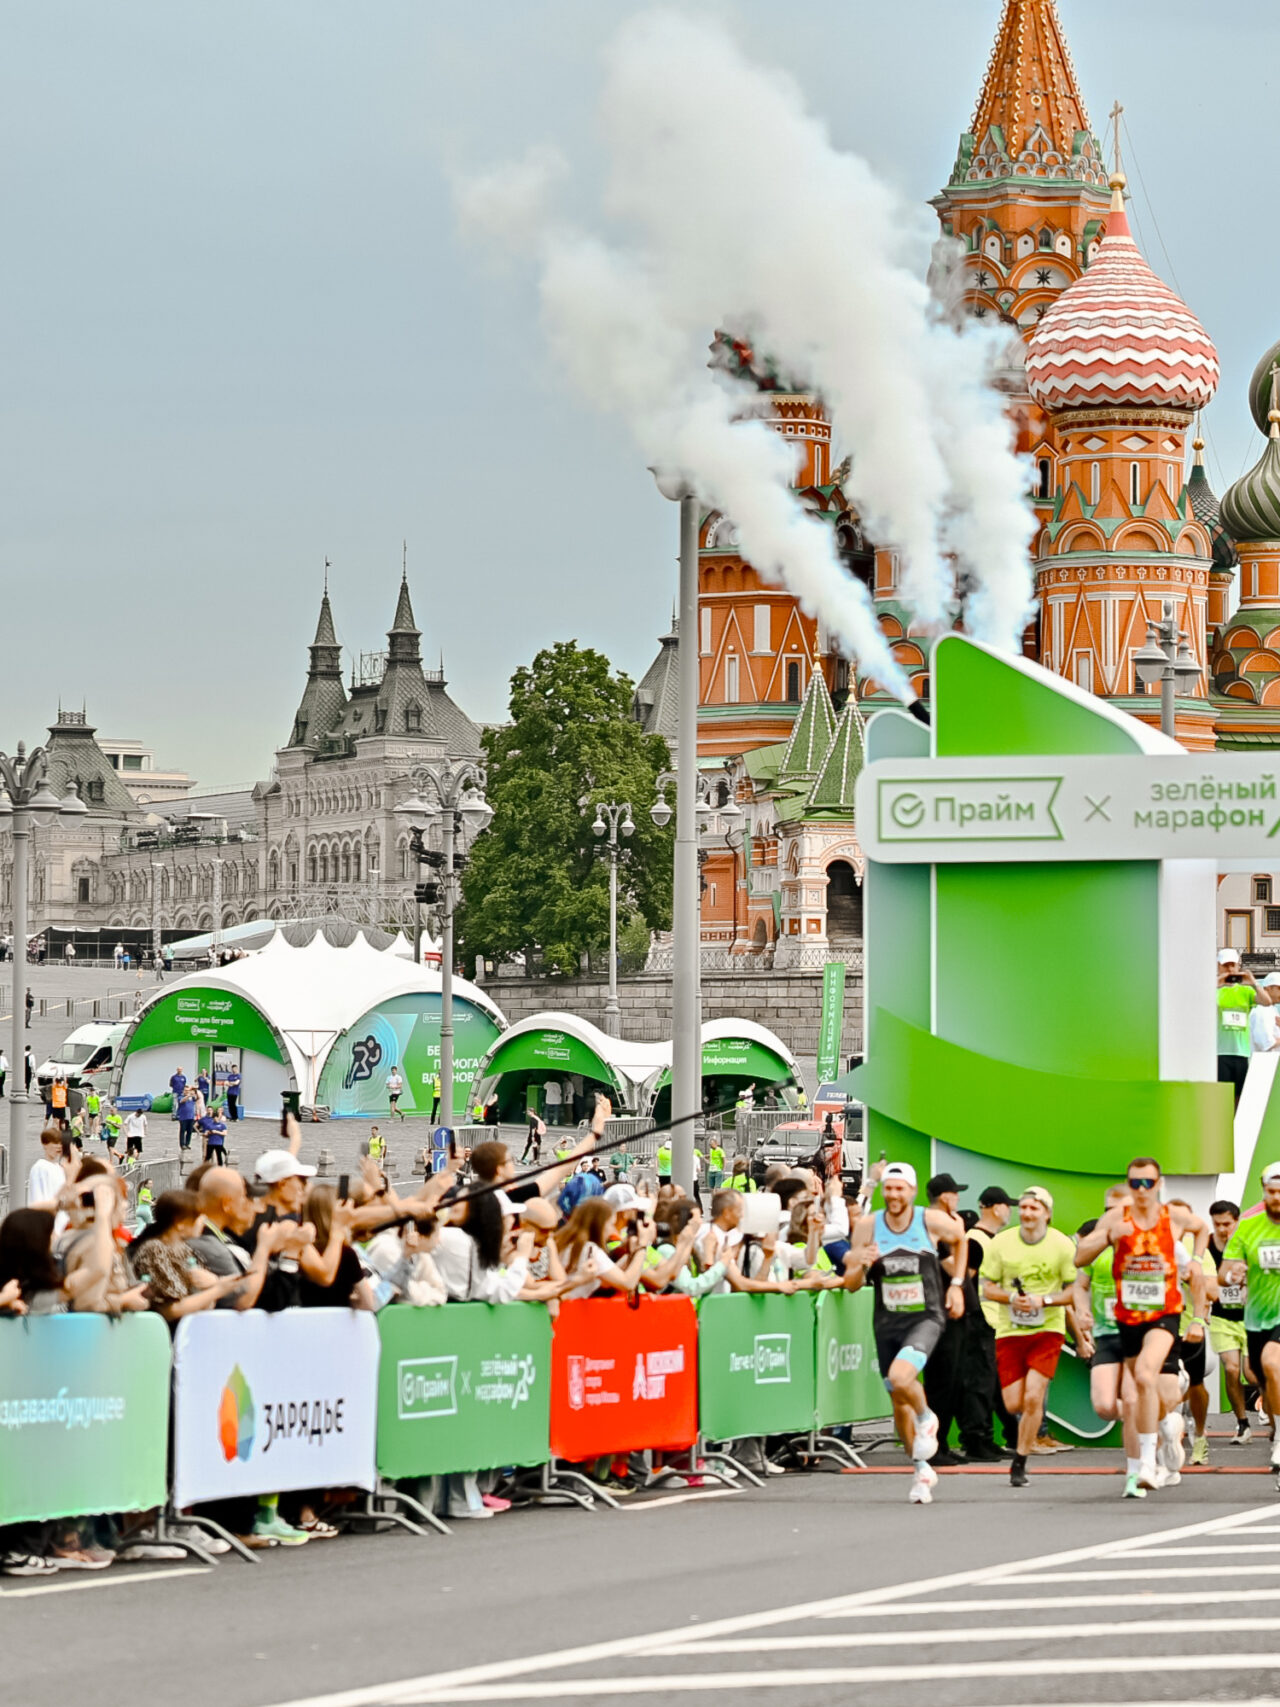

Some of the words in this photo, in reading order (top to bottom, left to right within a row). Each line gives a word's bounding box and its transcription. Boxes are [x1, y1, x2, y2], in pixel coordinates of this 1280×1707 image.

[1150, 774, 1277, 801] зелёный
[934, 794, 1036, 828] Прайм
[1134, 804, 1265, 833] марафон
[826, 971, 838, 1051] ИНФОРМАЦИЯ
[434, 1057, 482, 1069] ПМОГА
[703, 1055, 747, 1066] Информация
[1128, 1284, 1159, 1296] 7608
[480, 1353, 518, 1377] зелёный
[766, 1346, 786, 1371] Прайм
[840, 1343, 863, 1371] СБЕР
[416, 1373, 450, 1403] Прайм
[475, 1378, 515, 1404] марафон
[263, 1398, 344, 1453] ЗАРЯДЬЕ
